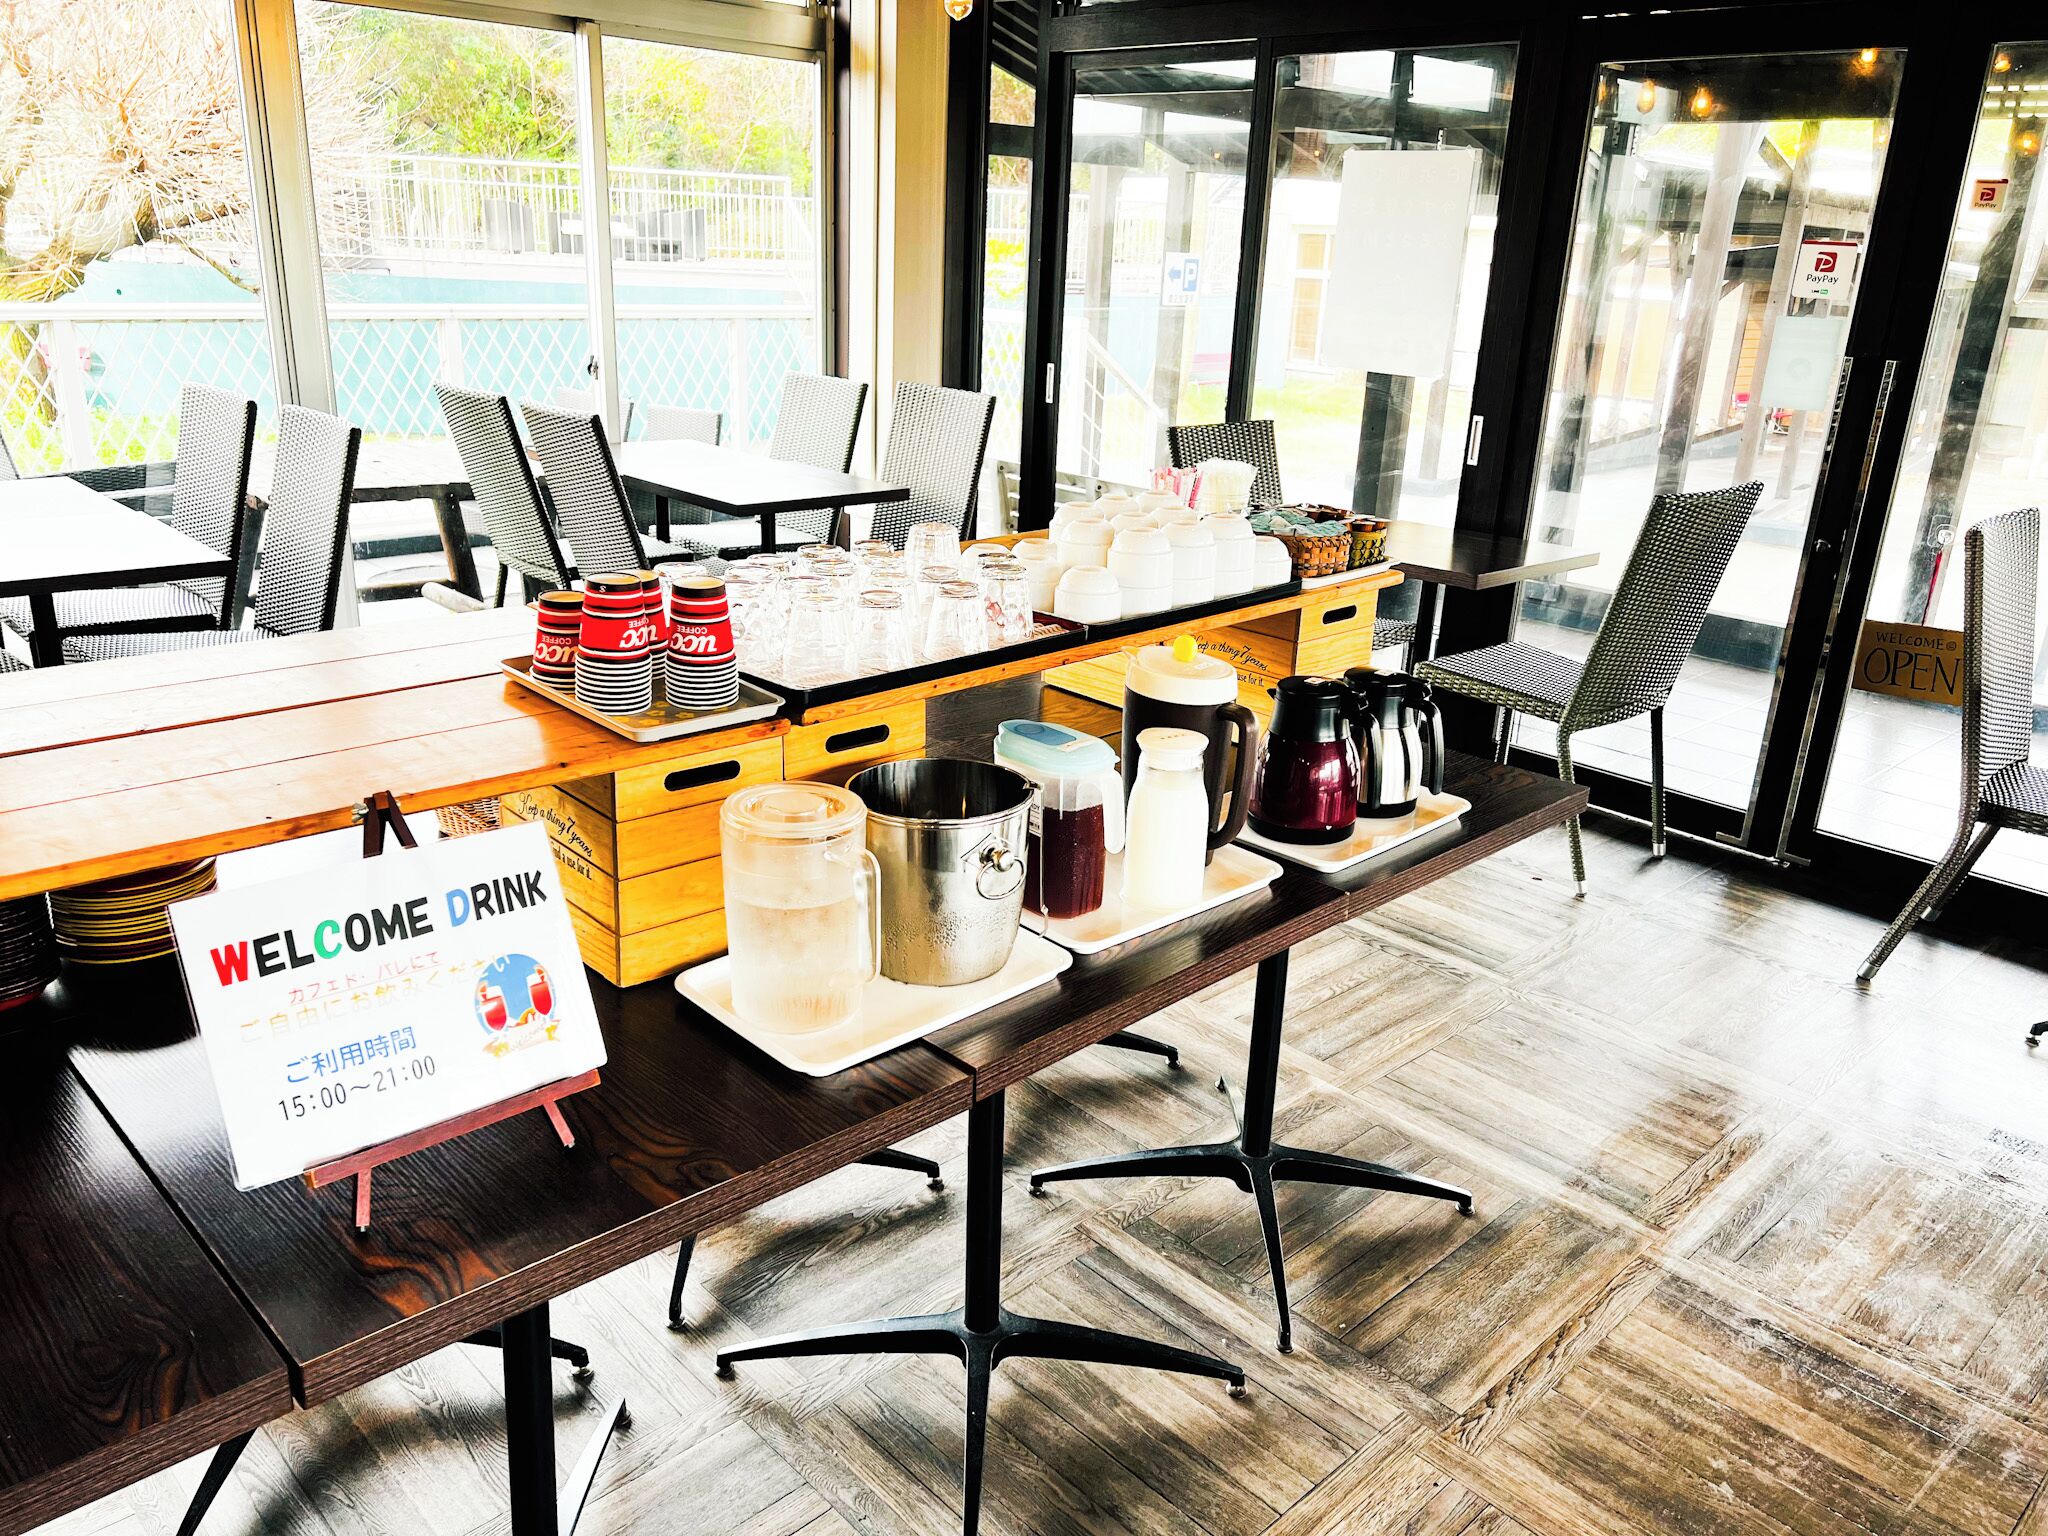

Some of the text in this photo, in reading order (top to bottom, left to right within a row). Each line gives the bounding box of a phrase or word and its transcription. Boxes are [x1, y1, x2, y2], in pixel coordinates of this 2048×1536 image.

[1806, 273, 1839, 285] PayPay
[541, 634, 572, 645] COFFEE
[676, 624, 708, 634] COFFEE
[1876, 631, 1945, 651] WELCOME
[1210, 643, 1217, 651] a
[1217, 641, 1241, 660] thing
[1240, 645, 1252, 658] 7
[1863, 647, 1961, 695] OPEN
[518, 792, 593, 858] Keep a thing 7 years
[209, 869, 548, 987] WELCOME DRINK
[239, 953, 512, 1044] ご自由にお飲みください
[285, 1026, 418, 1084] ご利用時間
